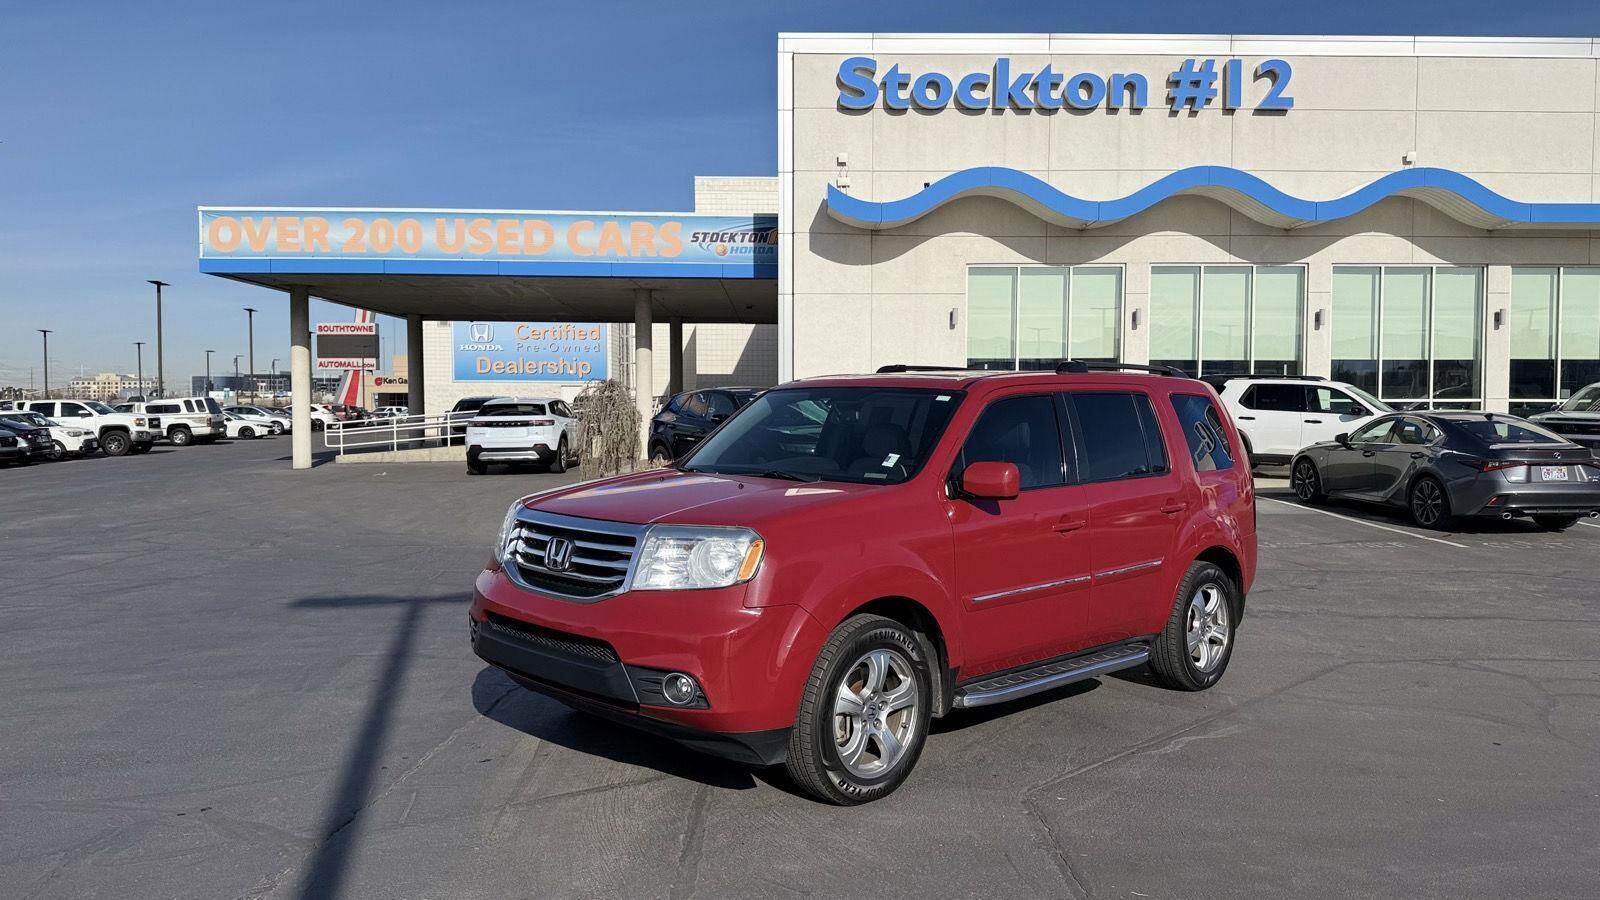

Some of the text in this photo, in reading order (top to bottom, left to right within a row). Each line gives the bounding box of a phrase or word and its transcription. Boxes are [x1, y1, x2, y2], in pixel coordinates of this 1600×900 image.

[838, 56, 1295, 113] Stockton #12
[208, 216, 683, 258] OVER 200 USED CARS
[690, 231, 768, 244] STOCKTON
[729, 245, 774, 255] HONDA
[318, 325, 374, 333] SOUTHTOWNE
[515, 322, 601, 341] Certified
[460, 344, 504, 352] HONDA
[516, 342, 601, 353] Pre-Owned
[476, 355, 592, 378] Dealership
[383, 377, 398, 385] Ken
